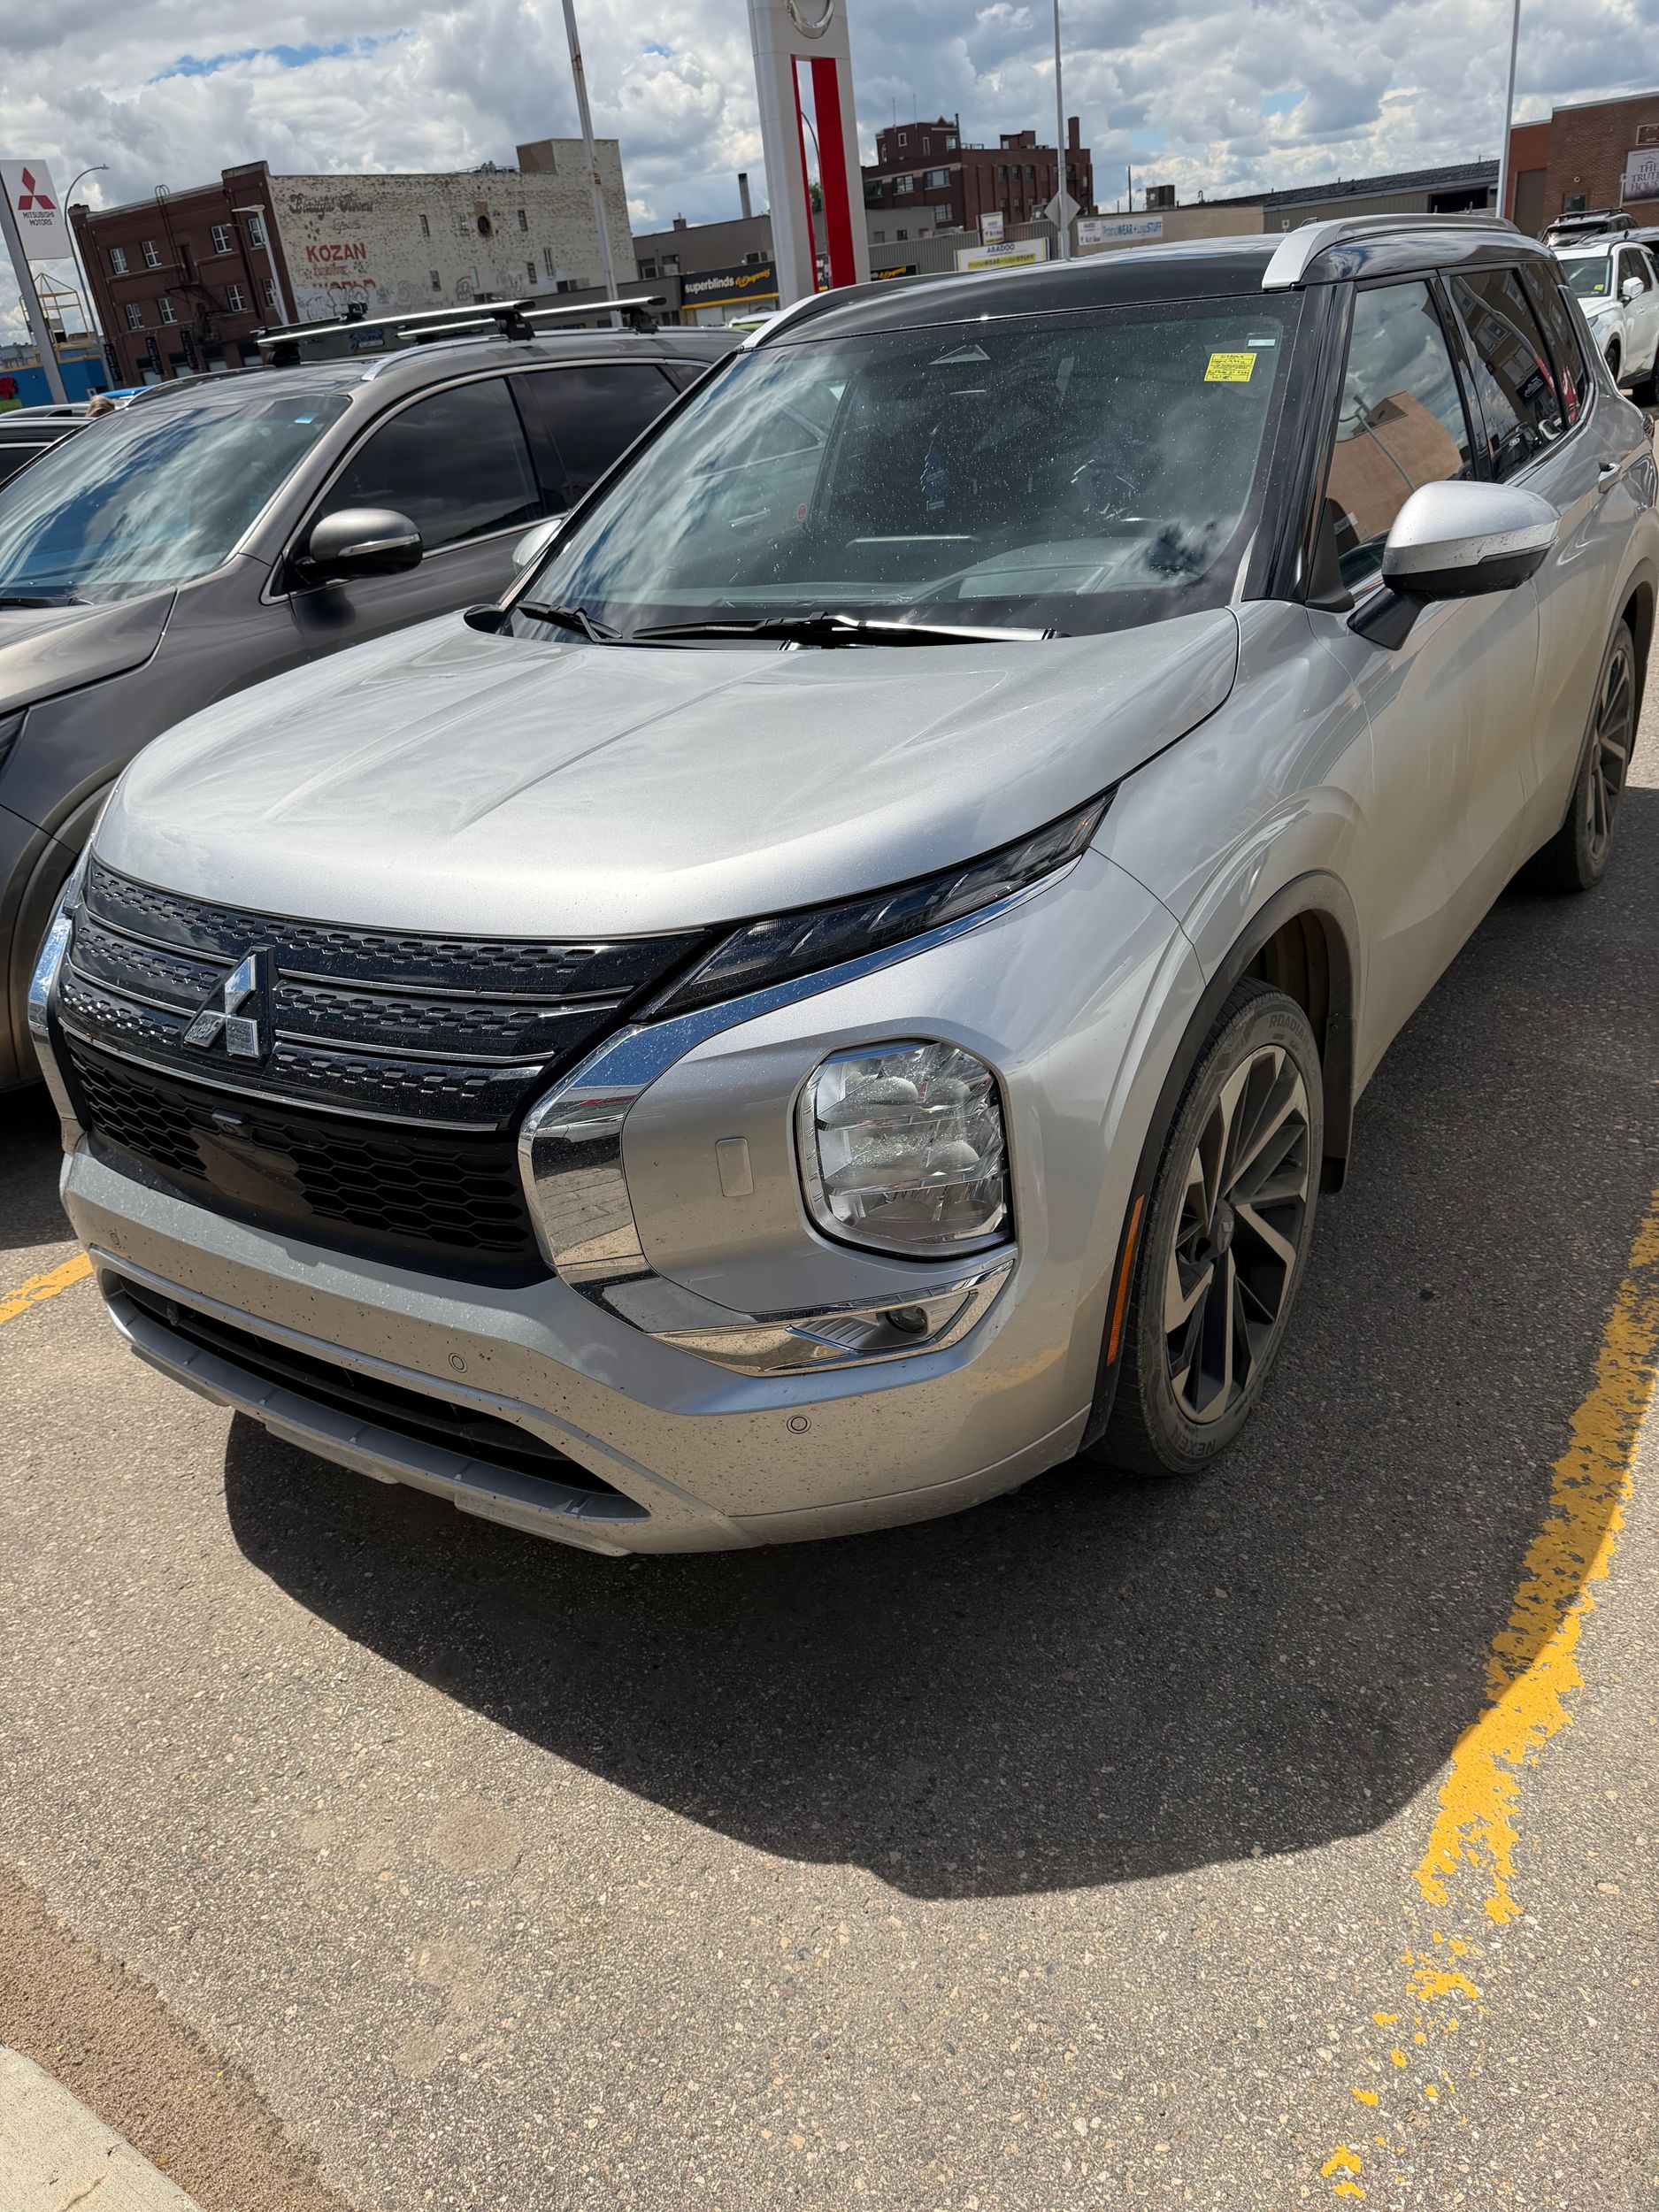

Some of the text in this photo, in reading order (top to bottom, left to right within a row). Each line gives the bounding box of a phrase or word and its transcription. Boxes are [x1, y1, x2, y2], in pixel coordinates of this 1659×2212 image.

[305, 242, 366, 263] KOZAN
[685, 275, 734, 294] superblinds
[1171, 1424, 1217, 1456] NEXEN
